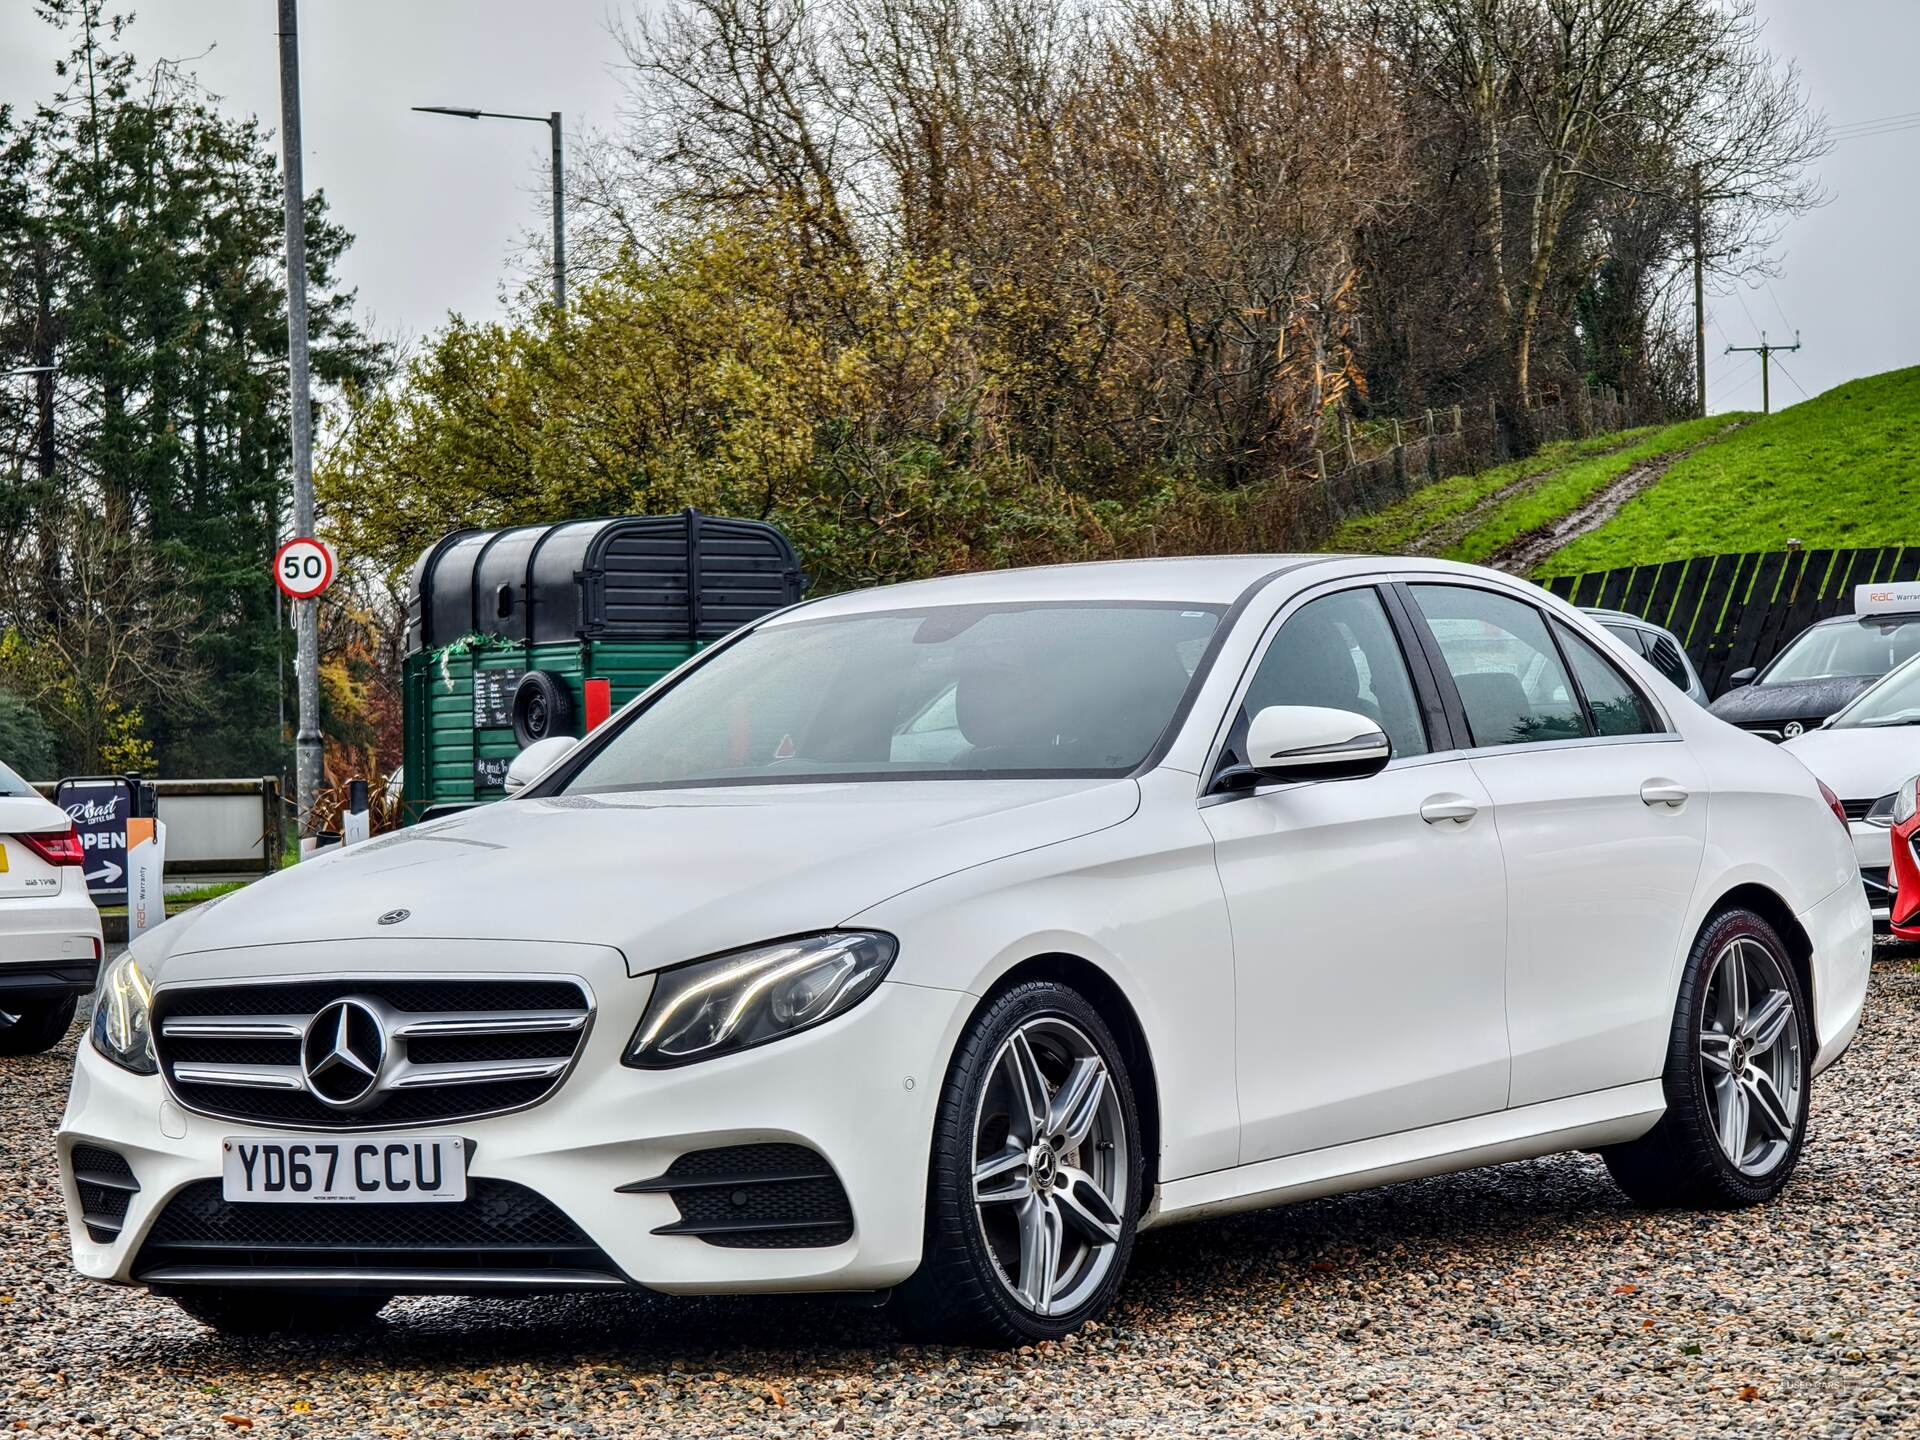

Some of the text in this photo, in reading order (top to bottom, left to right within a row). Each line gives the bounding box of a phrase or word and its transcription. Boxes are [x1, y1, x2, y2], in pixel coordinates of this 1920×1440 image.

[284, 555, 322, 579] 50
[238, 1144, 442, 1192] YD67 CCU
